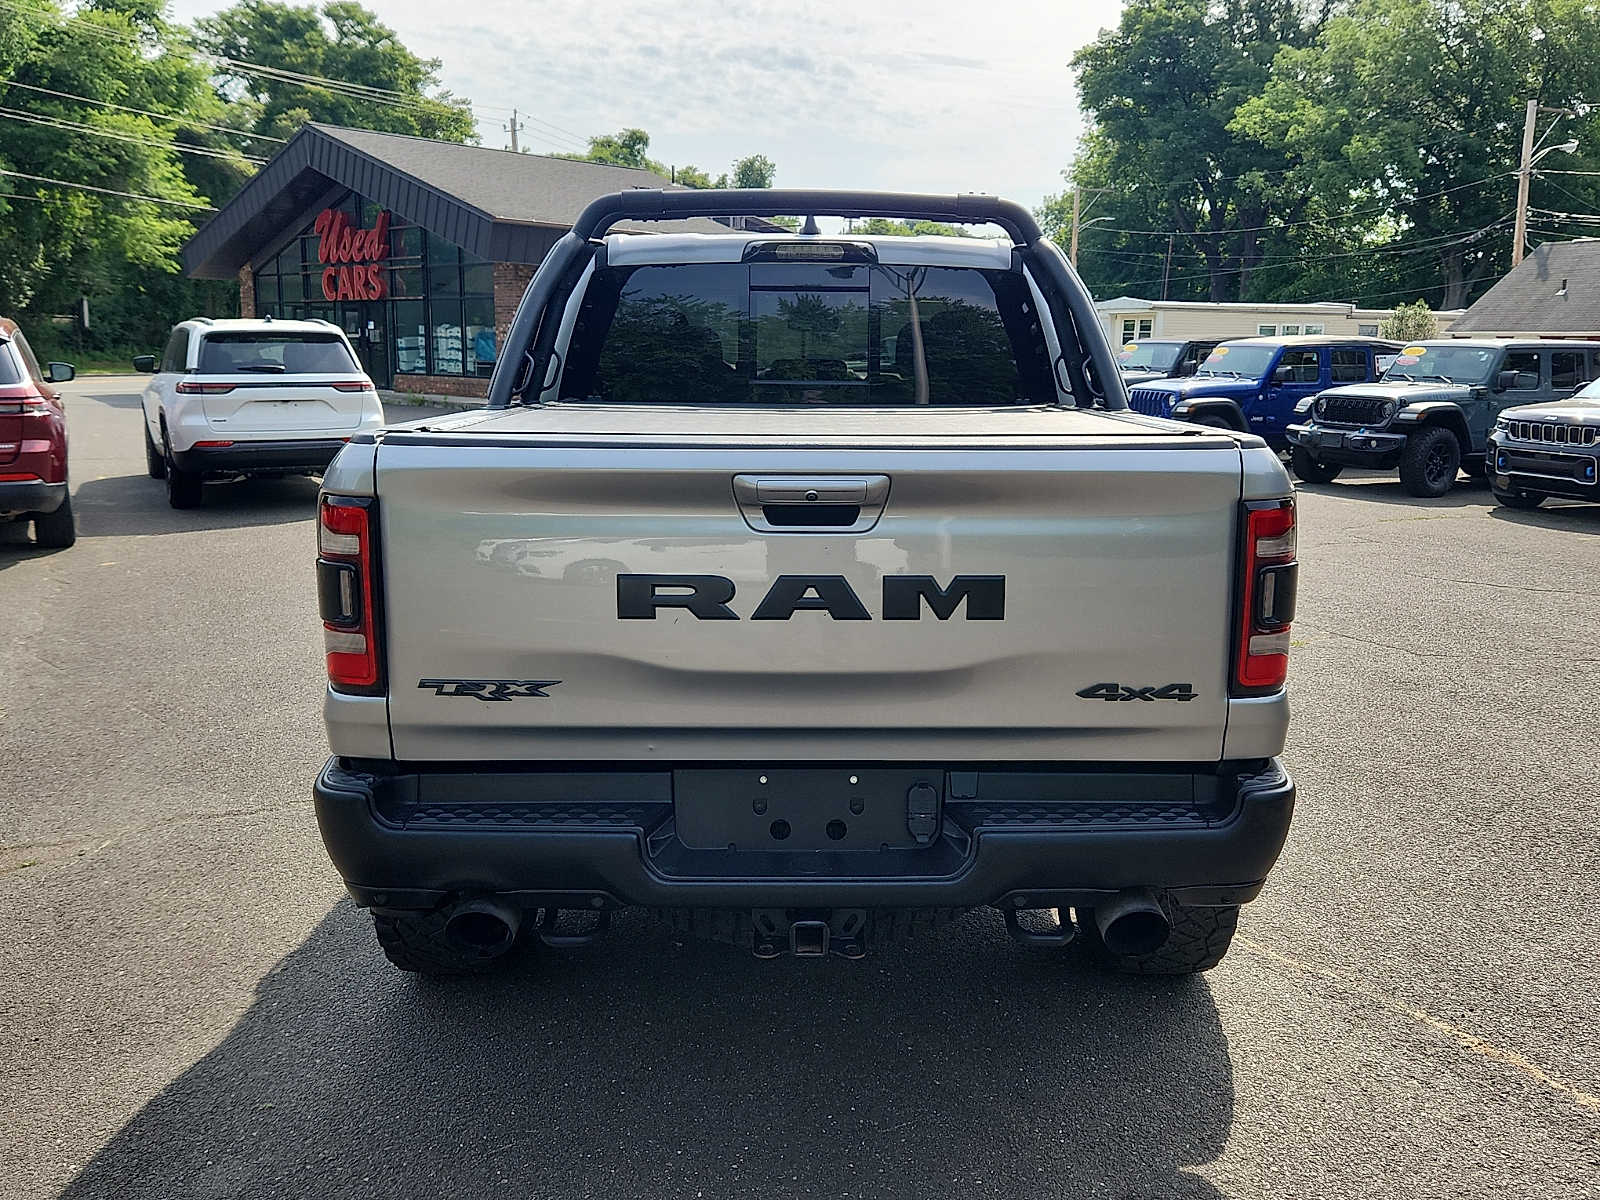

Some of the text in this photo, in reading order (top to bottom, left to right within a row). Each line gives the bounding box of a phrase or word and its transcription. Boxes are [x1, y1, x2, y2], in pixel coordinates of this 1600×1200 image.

[314, 208, 387, 264] Used
[322, 263, 385, 301] CARS
[617, 574, 1006, 620] RAM
[418, 679, 563, 701] TRX
[1075, 683, 1199, 701] 4x4
